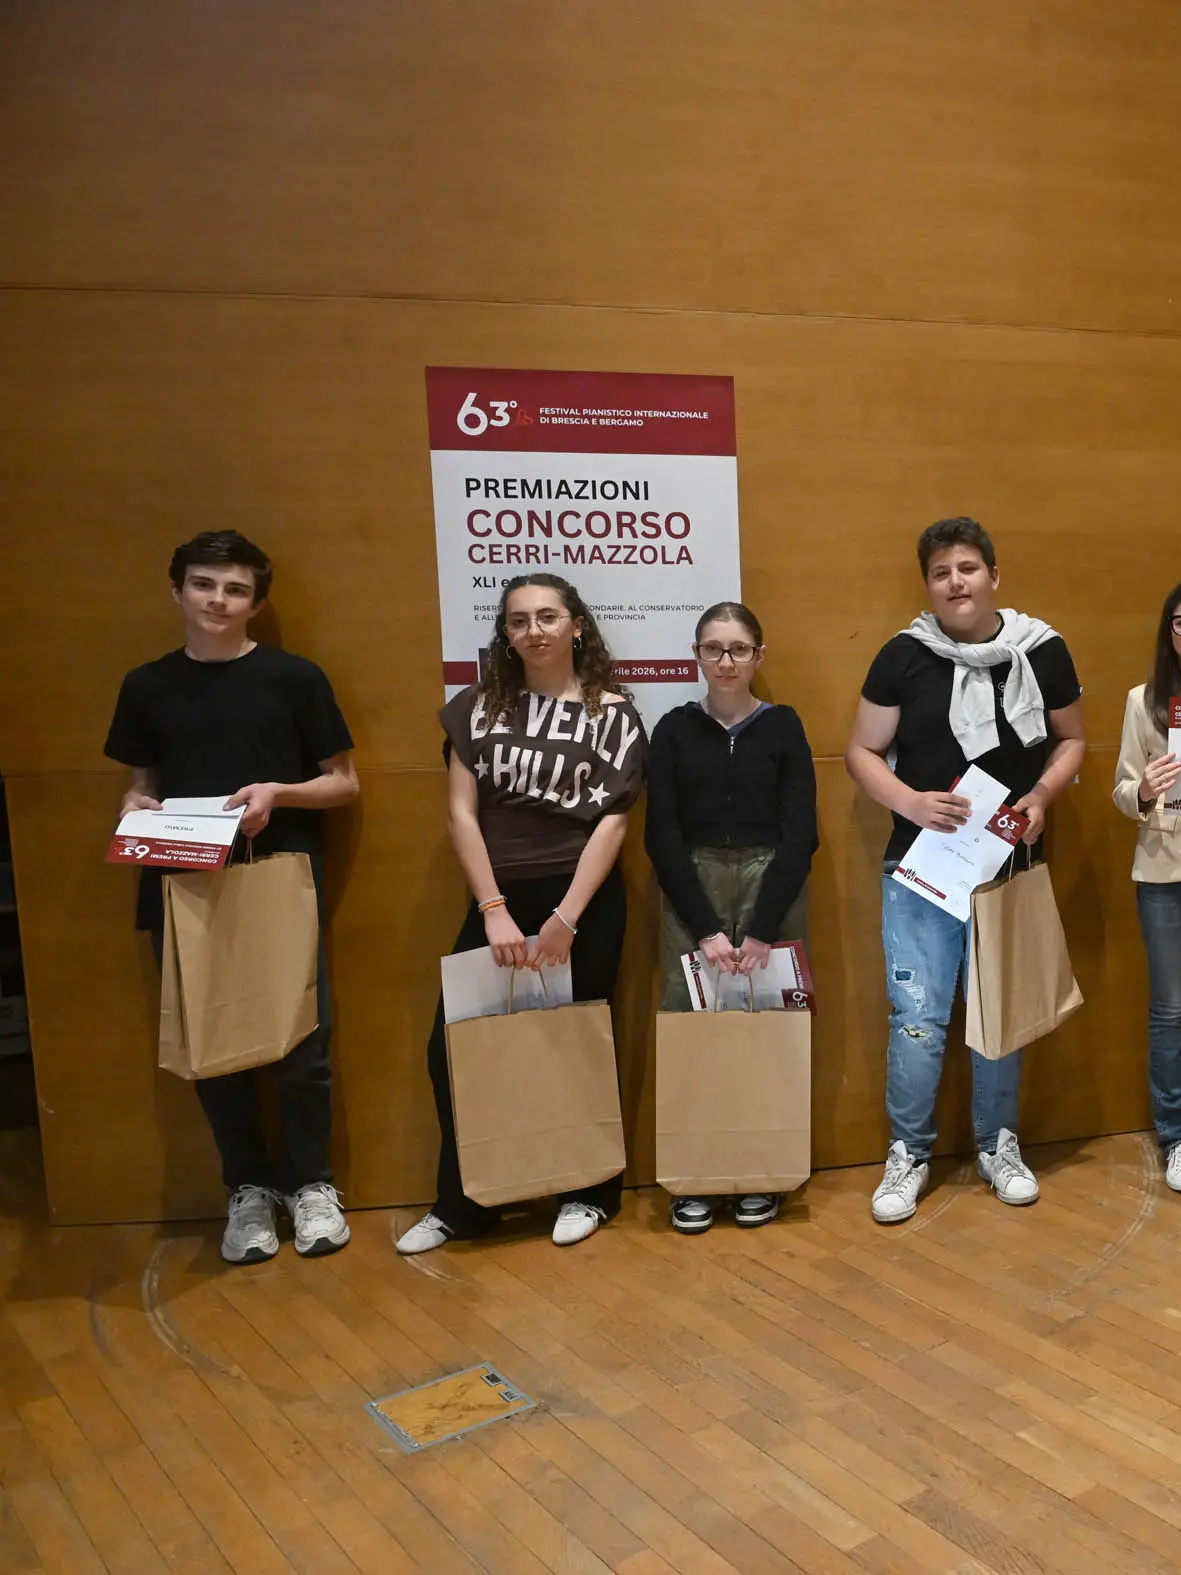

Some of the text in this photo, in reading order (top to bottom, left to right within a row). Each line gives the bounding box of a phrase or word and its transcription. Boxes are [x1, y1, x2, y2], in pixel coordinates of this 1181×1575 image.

[539, 407, 709, 419] FESTIVAL PIANISTICO INTERNAZIONALE
[552, 417, 589, 425] BRESCIA
[599, 418, 644, 426] BERGAMO
[464, 477, 649, 501] PREMIAZIONI
[466, 509, 691, 539] CONCORSO
[467, 543, 694, 565] CERRI-MAZZOLA
[472, 576, 496, 588] XLI
[628, 604, 637, 612] AL
[639, 604, 705, 612] CONSERVATORIO
[614, 667, 689, 677] rile 2026, ore 16
[493, 743, 592, 809] HILLS
